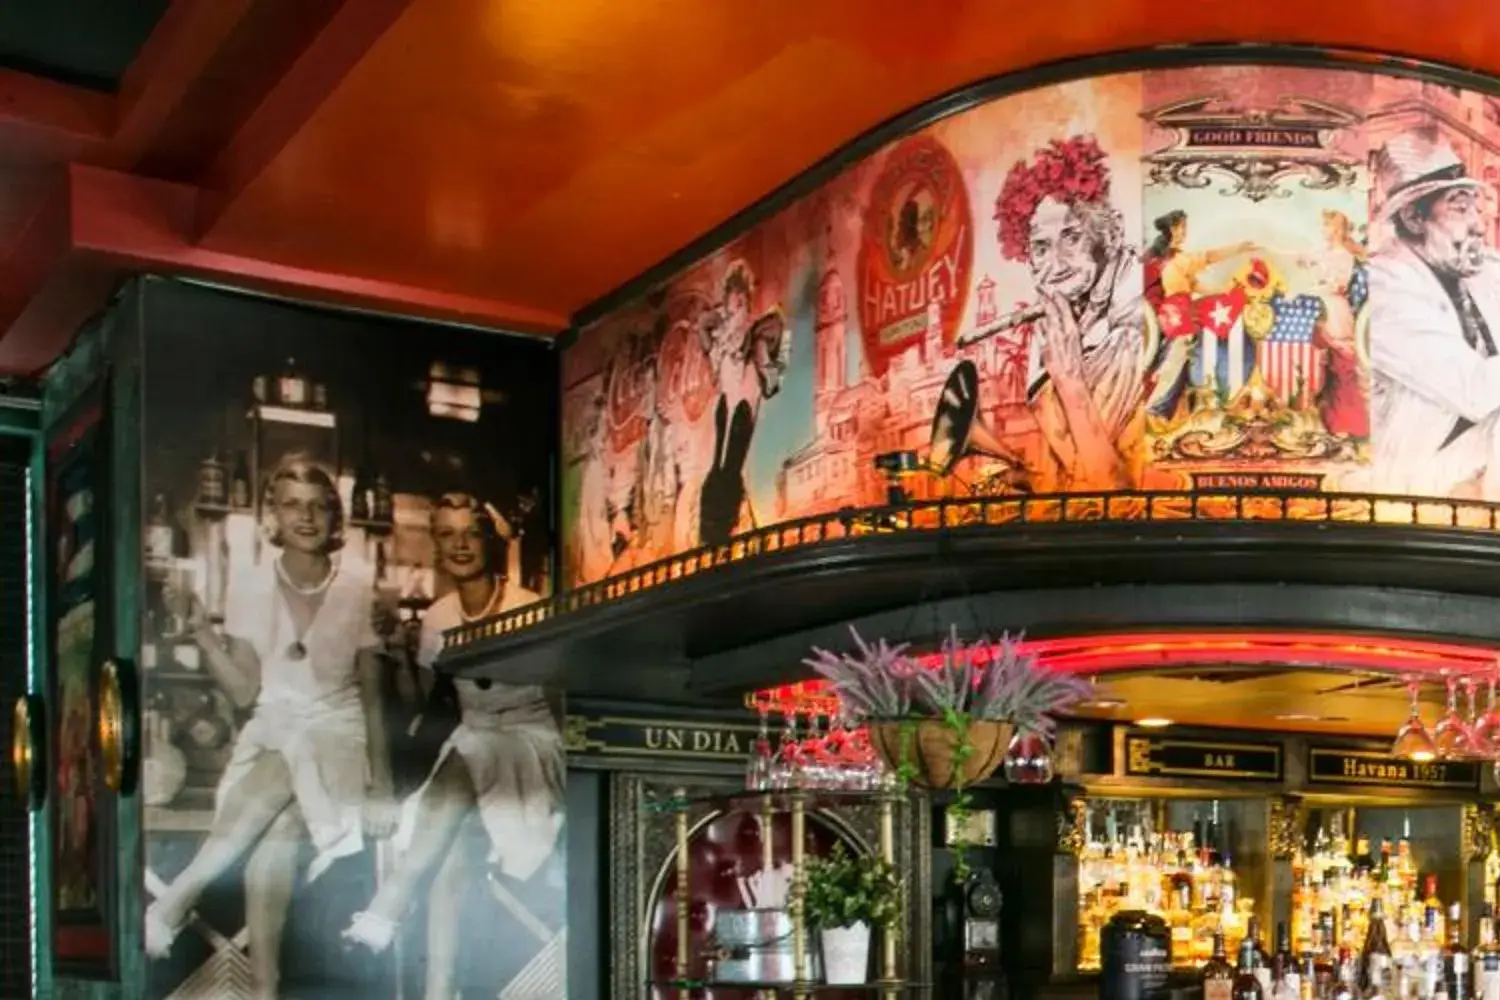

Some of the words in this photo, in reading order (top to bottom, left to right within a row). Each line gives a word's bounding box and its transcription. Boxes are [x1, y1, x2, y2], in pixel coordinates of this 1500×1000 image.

[1193, 131, 1241, 143] GOOD
[1245, 131, 1315, 144] FRIENDS
[1260, 475, 1317, 490] AMIGOS
[644, 727, 684, 749] UN
[693, 731, 740, 752] DIA
[1204, 753, 1236, 768] BAR
[1343, 758, 1408, 778] Havana
[1413, 765, 1447, 780] 1957
